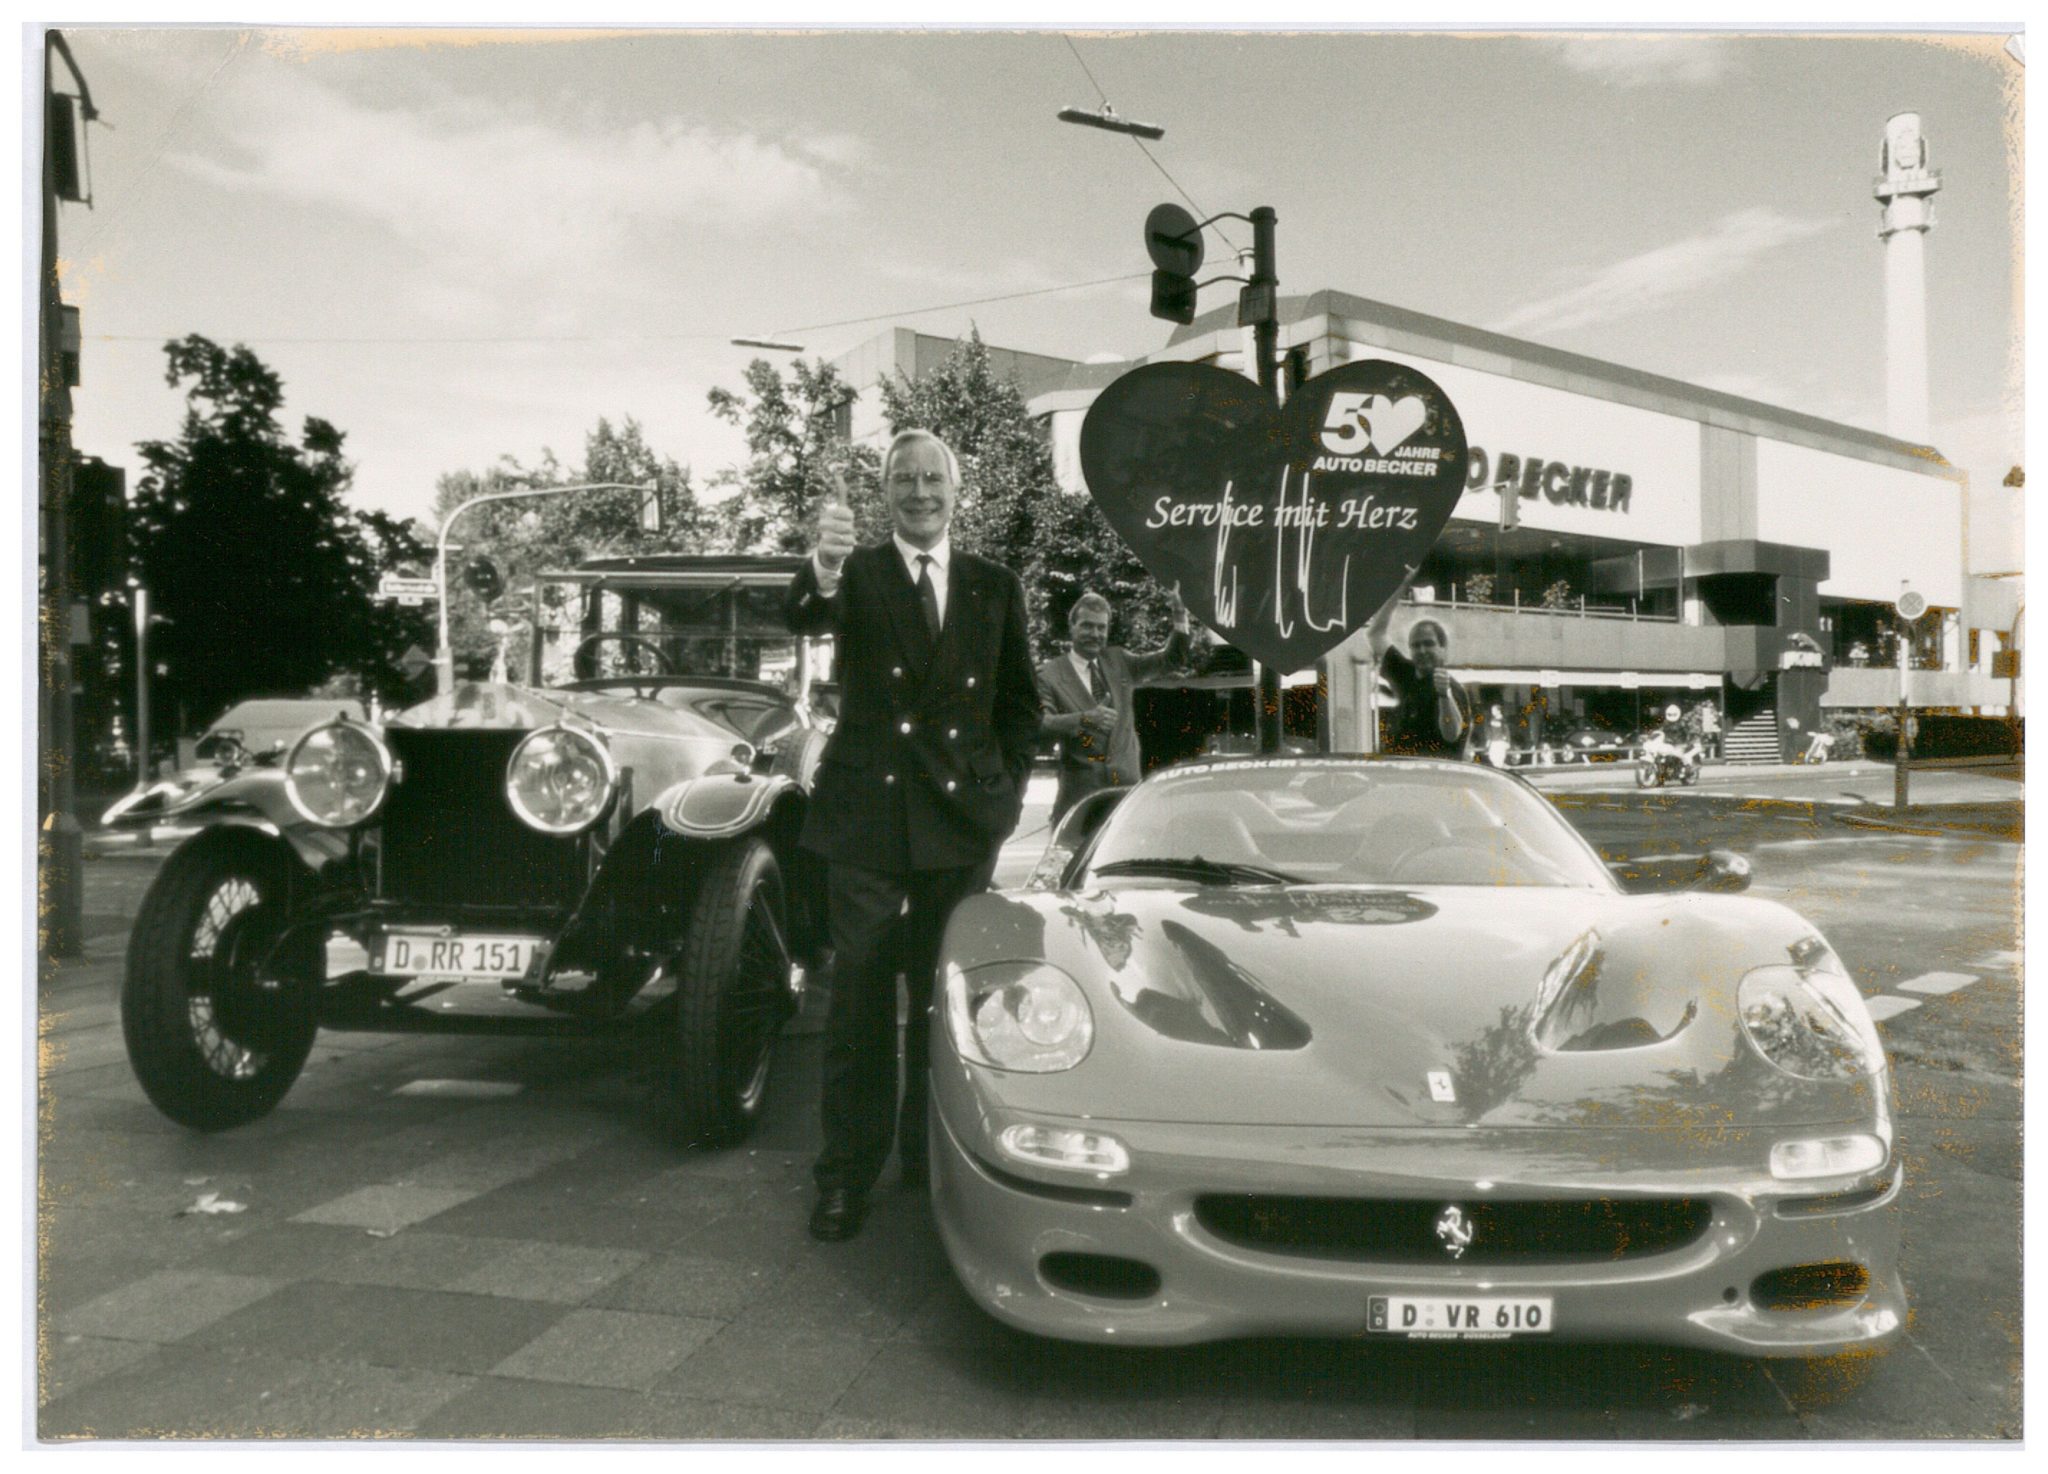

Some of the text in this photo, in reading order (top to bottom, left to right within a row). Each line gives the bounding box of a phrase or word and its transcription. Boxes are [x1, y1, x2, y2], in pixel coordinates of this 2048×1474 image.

[1395, 446, 1441, 459] JAHRE
[1313, 456, 1438, 476] AUTO BECKER
[1494, 452, 1632, 514] BECKER
[1146, 495, 1418, 530] Service mit Herz
[1153, 764, 1210, 782] AUTO
[394, 940, 521, 972] D RR 151
[1402, 1304, 1542, 1328] D VR 610
